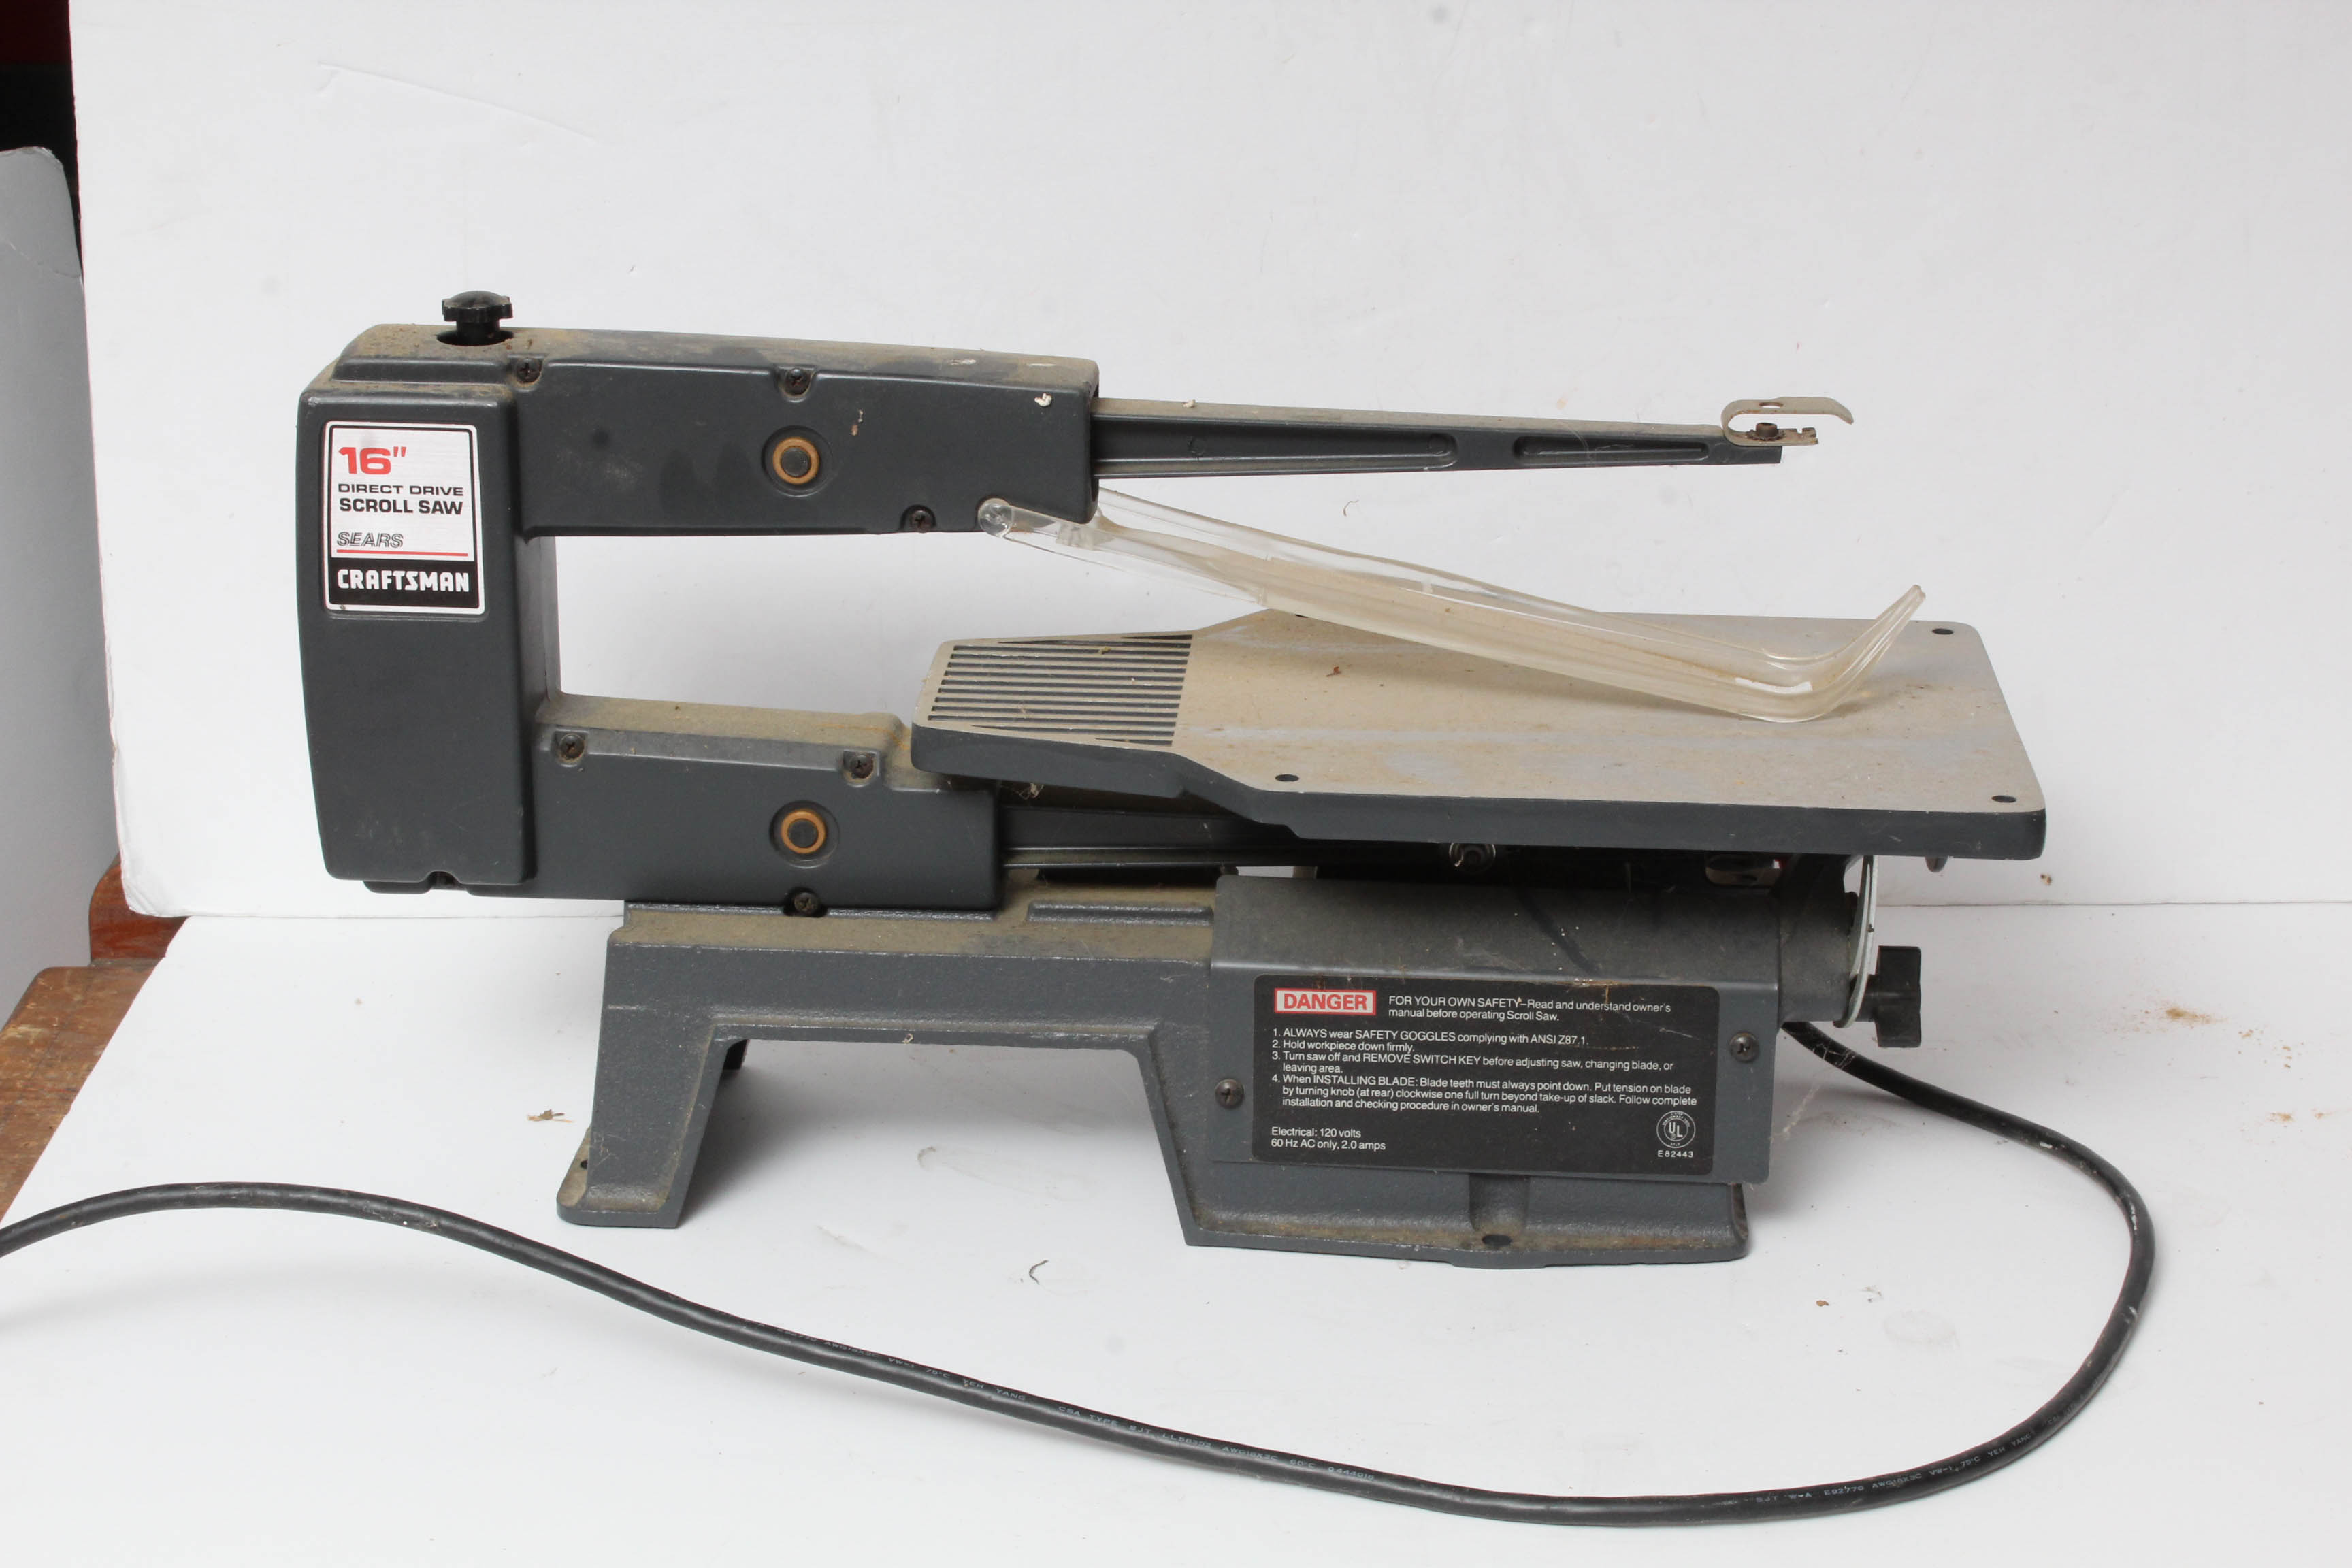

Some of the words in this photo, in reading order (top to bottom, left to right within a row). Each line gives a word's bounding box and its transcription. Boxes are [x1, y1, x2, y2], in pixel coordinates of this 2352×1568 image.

[338, 446, 406, 475] 16"
[338, 483, 403, 494] DIRECT
[410, 485, 464, 496] DRIVE
[339, 498, 414, 513] SCROLL
[418, 500, 463, 515] SAW
[337, 532, 404, 548] SEARS
[337, 569, 470, 592] CRAFTSMAN
[1284, 993, 1367, 1010] DANGER
[1388, 995, 1412, 1005] FOR
[1414, 996, 1446, 1007] YOUR
[1448, 996, 1475, 1007] OWN
[1555, 1000, 1573, 1010] and
[1575, 1000, 1631, 1011] understand
[1633, 1002, 1671, 1013] owner's
[1388, 1008, 1424, 1017] manual
[1426, 1008, 1458, 1019] before
[1459, 1009, 1505, 1022] operating
[1507, 1010, 1533, 1021] Scroll
[1535, 1011, 1559, 1022] Saw.
[1273, 1027, 1280, 1037] 1.
[1283, 1027, 1327, 1038] ALWAYS
[1328, 1030, 1353, 1039] wear
[1354, 1029, 1398, 1040] SAFETY
[1400, 1030, 1456, 1042] GOGGLES
[1457, 1032, 1507, 1045] complying
[1509, 1034, 1529, 1044] with
[1530, 1034, 1556, 1045] ANSI
[1557, 1034, 1588, 1045] Z87.1.
[1272, 1039, 1280, 1049] 2.
[1283, 1039, 1305, 1049] Hold
[1307, 1040, 1356, 1052] workpiece
[1358, 1041, 1384, 1051] down
[1386, 1042, 1414, 1054] firmly.
[1272, 1050, 1280, 1060] 3.
[1282, 1050, 1305, 1061] Turn
[1306, 1053, 1326, 1061] saw
[1328, 1051, 1341, 1062] off
[1341, 1052, 1360, 1062] and
[1362, 1052, 1411, 1064] REMOVE
[1412, 1054, 1456, 1065] SWITCH
[1458, 1055, 1480, 1066] KEY
[1482, 1056, 1514, 1066] before
[1515, 1057, 1559, 1070] adjusting
[1561, 1060, 1582, 1069] saw,
[1585, 1059, 1629, 1072] changing
[1631, 1060, 1661, 1072] blade,
[1663, 1062, 1673, 1071] or
[1283, 1062, 1317, 1075] leaving
[1318, 1065, 1343, 1074] area.
[1271, 1073, 1280, 1083] 4.
[1282, 1073, 1311, 1084] When
[1313, 1074, 1376, 1085] INSTALLING
[1377, 1076, 1418, 1087] BLADE:
[1420, 1077, 1448, 1088] Blade
[1450, 1078, 1474, 1088] teeth
[1476, 1079, 1500, 1090] must
[1501, 1079, 1535, 1092] always
[1537, 1081, 1561, 1092] point
[1563, 1081, 1592, 1092] down.
[1595, 1082, 1611, 1092] Put
[1612, 1083, 1648, 1094] tension
[1650, 1085, 1662, 1094] on
[1664, 1084, 1691, 1094] blade
[1282, 1085, 1294, 1097] by
[1295, 1085, 1328, 1098] turning
[1330, 1086, 1355, 1097] knob
[1356, 1087, 1369, 1099] (at
[1371, 1089, 1394, 1100] rear)
[1395, 1088, 1443, 1099] clockwise
[1444, 1091, 1463, 1100] one
[1465, 1090, 1479, 1100] full
[1480, 1090, 1499, 1101] turn
[1501, 1091, 1537, 1103] beyond
[1539, 1092, 1576, 1105] take-up
[1578, 1093, 1587, 1103] of
[1588, 1094, 1616, 1104] slack.
[1619, 1094, 1650, 1105] Follow
[1652, 1096, 1697, 1108] complete
[1282, 1096, 1333, 1108] installation
[1334, 1098, 1353, 1109] and
[1354, 1098, 1398, 1111] checking
[1400, 1100, 1449, 1112] procedure
[1451, 1101, 1459, 1111] in
[1461, 1102, 1499, 1113] owner's
[1501, 1103, 1539, 1113] manual.
[1271, 1126, 1317, 1137] Electrical:
[1320, 1128, 1337, 1138] 120
[1338, 1128, 1361, 1139] volts
[1669, 1122, 1683, 1137] UL
[1271, 1137, 1284, 1147] 60
[1285, 1138, 1298, 1148] Hz
[1300, 1138, 1315, 1148] AC
[1317, 1139, 1339, 1151] only,
[1341, 1139, 1357, 1149] 2.0
[1358, 1141, 1386, 1152] amps
[1657, 1149, 1694, 1158] E82443
[996, 1387, 1026, 1401] YANG
